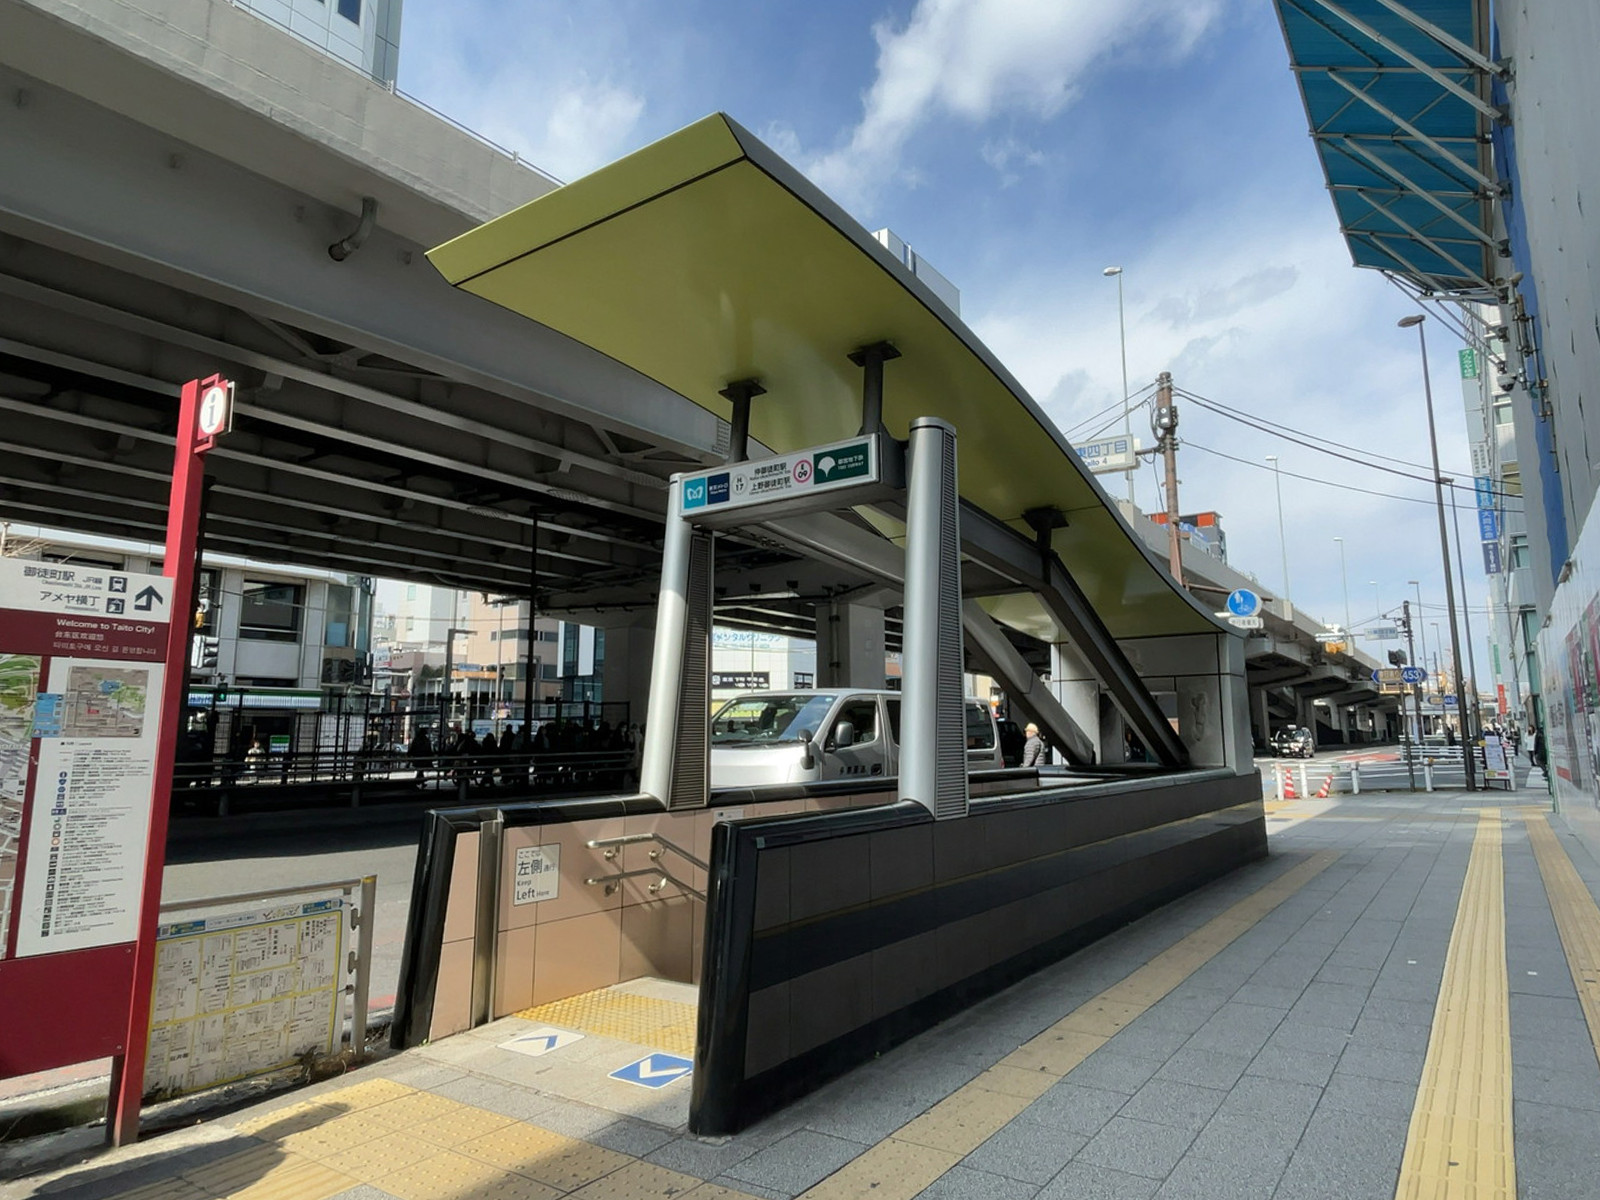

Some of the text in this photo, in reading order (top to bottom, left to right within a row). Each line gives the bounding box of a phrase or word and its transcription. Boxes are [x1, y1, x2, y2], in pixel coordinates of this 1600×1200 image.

[754, 462, 787, 475] 仲御徒町駅
[798, 470, 808, 478] 09
[735, 483, 744, 491] 17
[751, 476, 791, 491] 上野御徒町駅
[24, 566, 75, 581] 御徒町駅
[40, 591, 100, 606] アメヤ横丁
[57, 619, 98, 629] Welcome
[112, 623, 134, 631] Taito
[135, 626, 155, 634] City!
[1402, 670, 1420, 680] 453
[516, 888, 535, 900] Left
